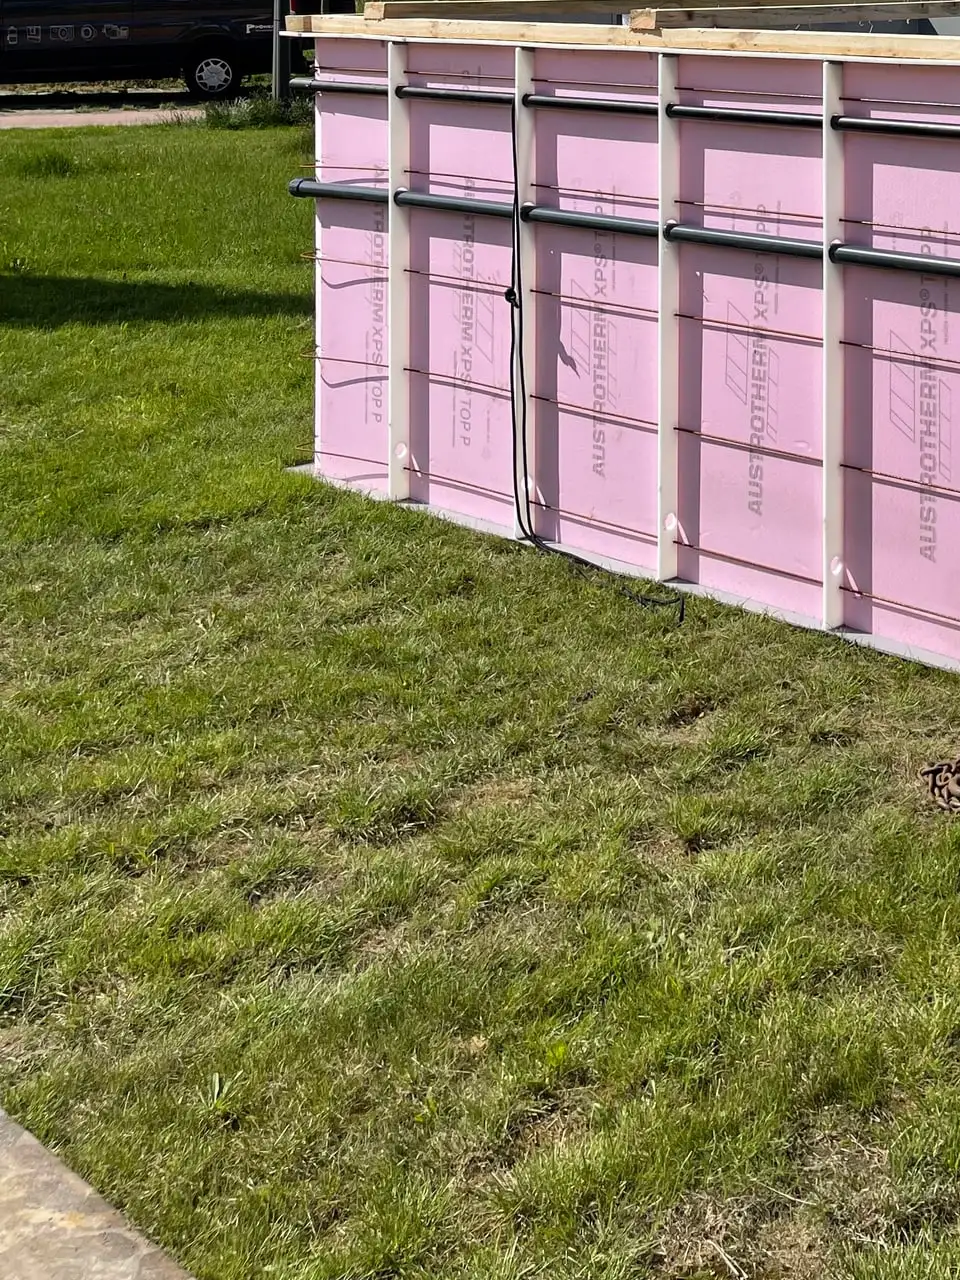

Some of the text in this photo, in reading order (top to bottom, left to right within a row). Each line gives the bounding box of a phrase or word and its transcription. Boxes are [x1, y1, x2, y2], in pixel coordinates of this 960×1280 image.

[460, 398, 472, 432] TOP
[460, 435, 471, 446] P
[919, 358, 937, 563] AUSTROTHERM
